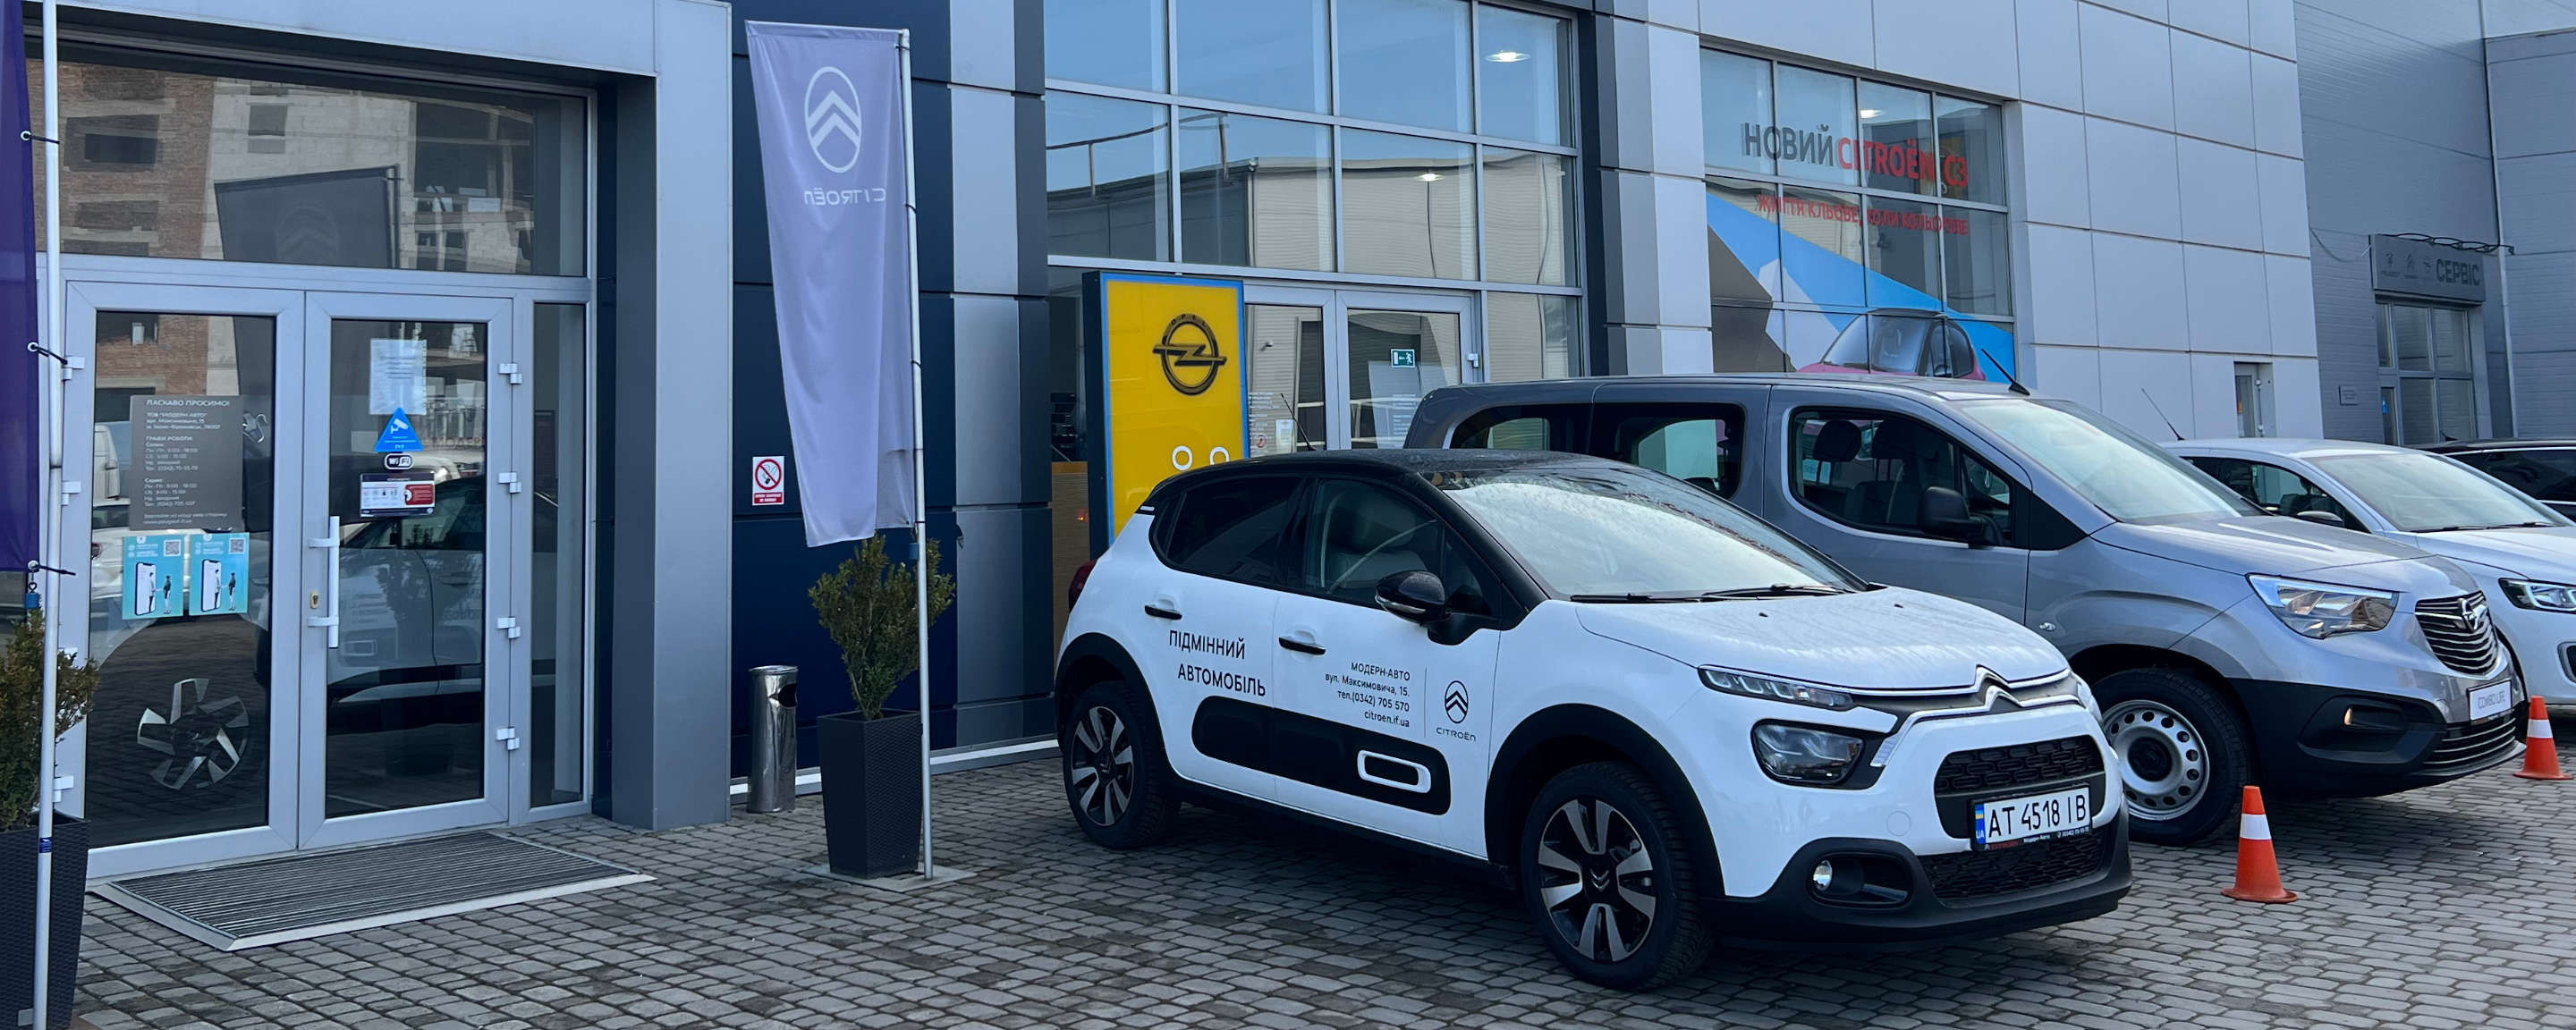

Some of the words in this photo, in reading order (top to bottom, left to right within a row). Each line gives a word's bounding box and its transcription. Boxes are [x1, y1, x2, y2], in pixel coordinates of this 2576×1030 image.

[1743, 122, 1834, 167] НОВИЙ
[1838, 137, 1936, 182] CITROËN
[1945, 154, 1968, 187] C3
[2436, 258, 2481, 286] СЕРВІС
[1169, 629, 1246, 660] ПІДМІННИЙ
[1177, 663, 1266, 697] АВТОМОБІЛЬ
[1325, 673, 1340, 685] вул.
[1342, 675, 1397, 695] Максимовича,
[1351, 662, 1411, 681] МОДЕРН-АВТО
[1364, 710, 1411, 728] citroen.if.ua
[1377, 697, 1393, 709] 705
[1394, 700, 1410, 713] 570
[1988, 806, 2015, 838] AT
[2021, 798, 2060, 831] 4518
[2067, 794, 2087, 823] IB
